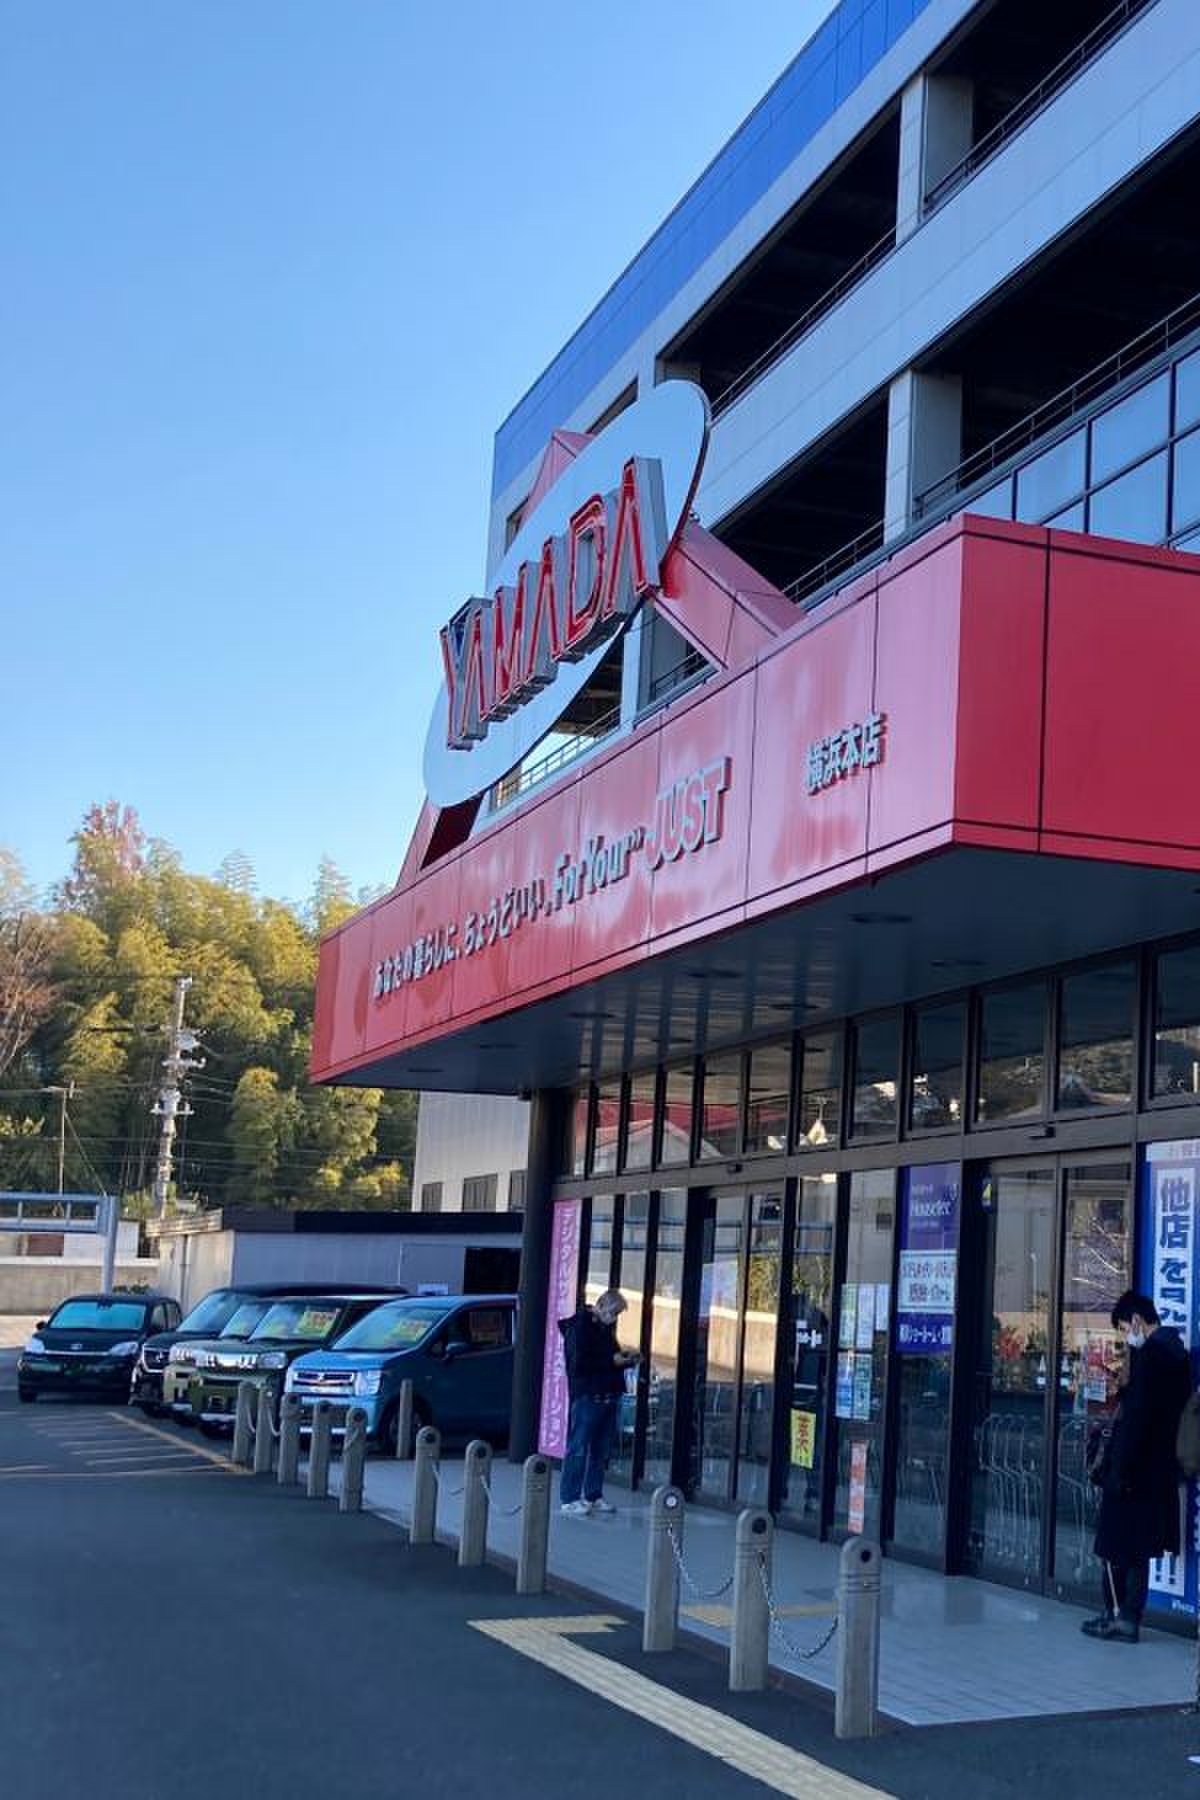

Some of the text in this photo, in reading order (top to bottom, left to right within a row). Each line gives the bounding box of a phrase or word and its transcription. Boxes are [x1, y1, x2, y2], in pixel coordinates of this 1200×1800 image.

[439, 456, 668, 751] YAMADA
[806, 712, 888, 797] 横浜本店
